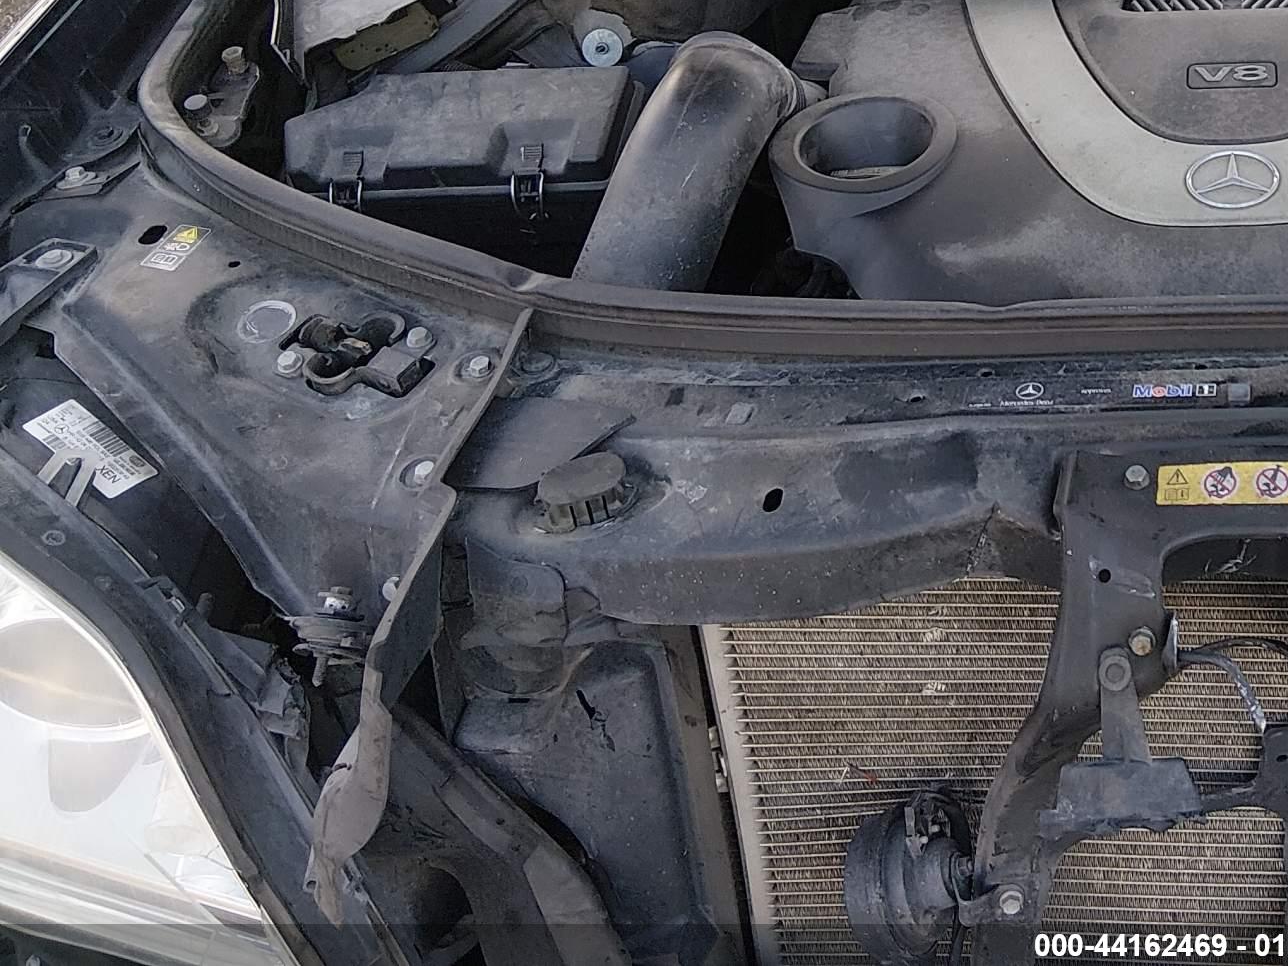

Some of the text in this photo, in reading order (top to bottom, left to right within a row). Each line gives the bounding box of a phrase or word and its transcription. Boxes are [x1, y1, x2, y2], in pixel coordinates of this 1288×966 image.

[1195, 64, 1269, 82] V8
[1132, 384, 1193, 398] Mobil
[95, 464, 122, 485] XEN
